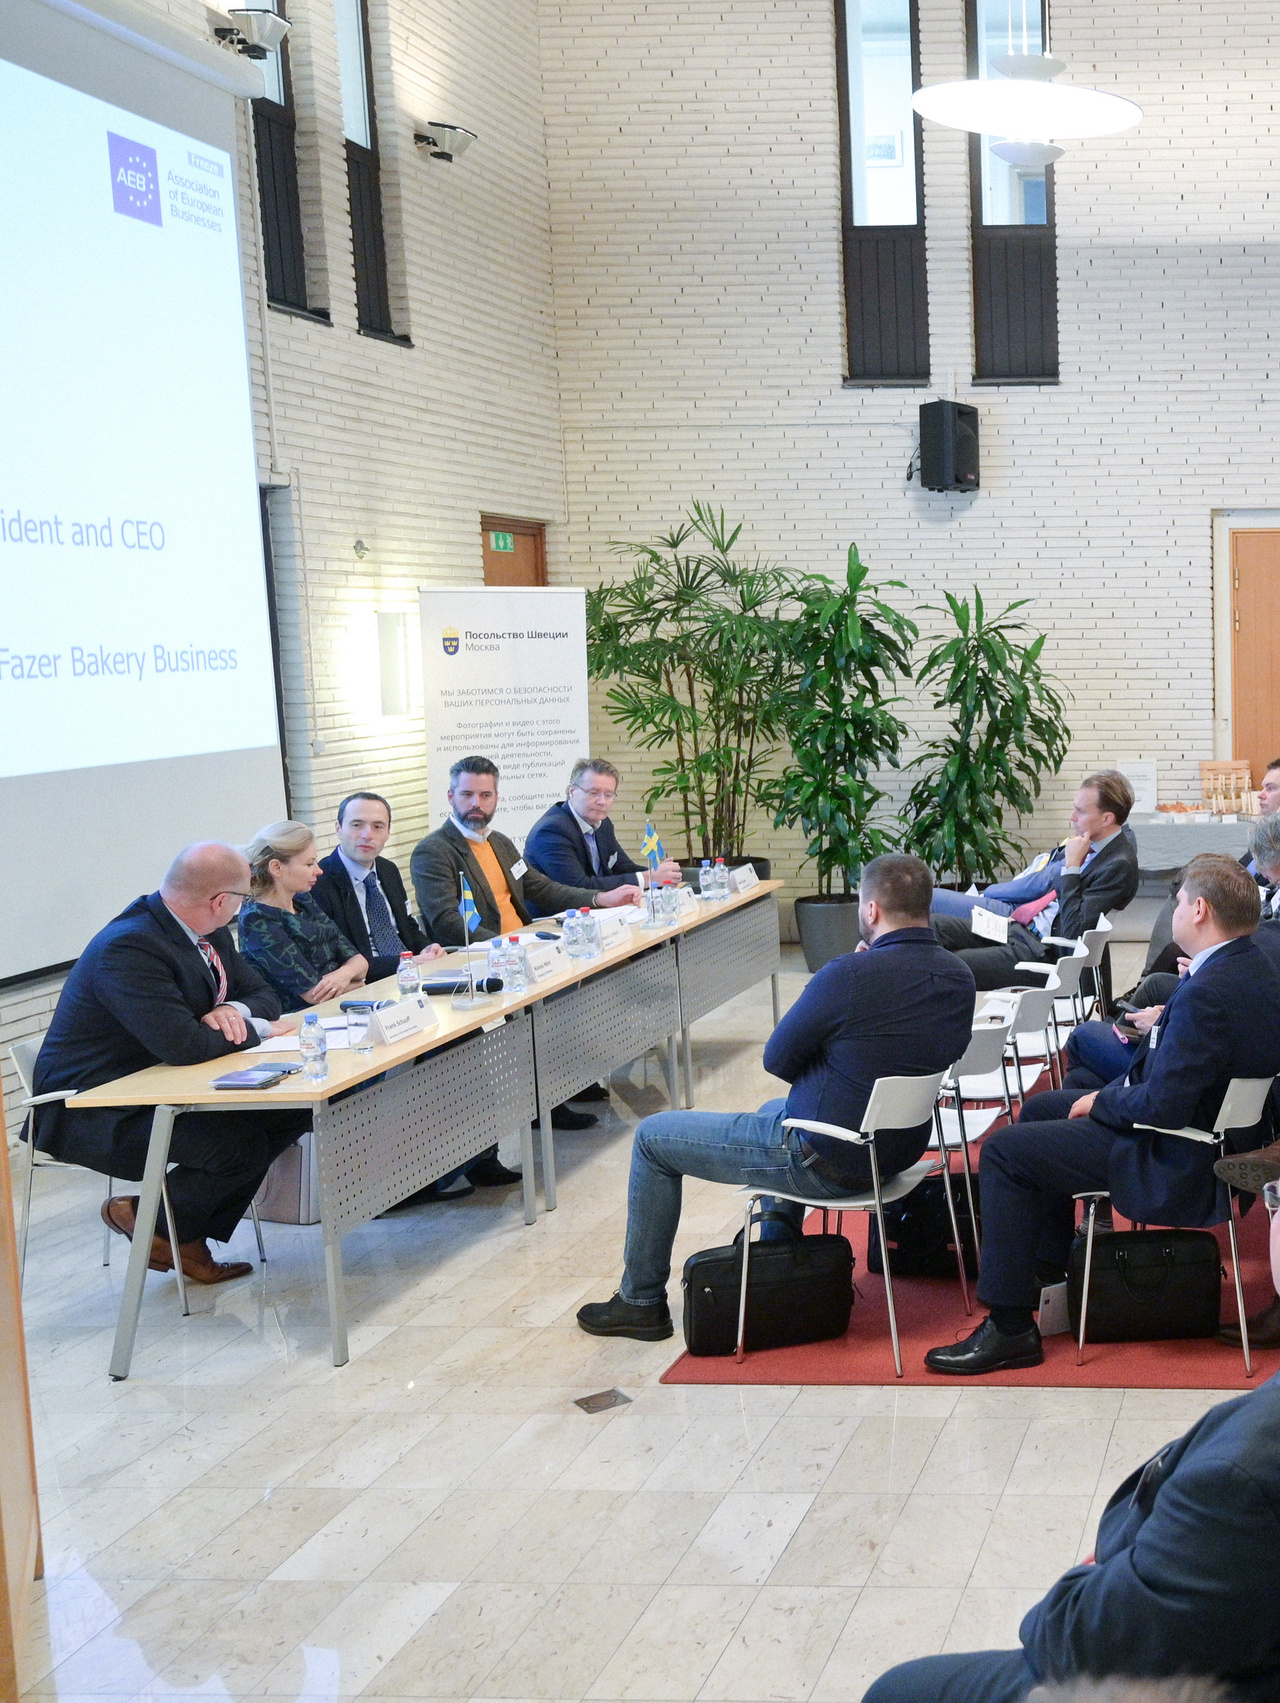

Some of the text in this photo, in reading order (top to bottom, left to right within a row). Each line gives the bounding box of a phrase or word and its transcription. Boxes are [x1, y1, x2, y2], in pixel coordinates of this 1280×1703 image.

[116, 166, 146, 192] AEB
[167, 170, 220, 200] Association
[169, 190, 224, 218] of European
[170, 203, 222, 232] Businesses
[71, 517, 113, 548] and
[120, 519, 166, 551] CEO
[465, 630, 569, 640] Посольство Швеции
[465, 643, 501, 652] Москва
[0, 643, 238, 681] Fazer Bakery Business
[440, 685, 573, 697] МЫ ЗАБОТИМСЯ О БЕЗОПАСНОСТИ
[444, 696, 570, 708] ВАШИХ ПЕРСОНАЛЬНЫХ ДАННЫХ
[456, 720, 504, 730] Фотографии
[512, 720, 535, 728] видео
[541, 718, 561, 726] этого
[440, 728, 576, 742] мероприятия могут быть сохранены
[443, 743, 500, 752] использованы
[500, 742, 514, 750] для
[515, 738, 580, 749] информирования
[502, 763, 521, 771] виде
[522, 759, 566, 770] публикаций
[508, 792, 545, 802] сообщите
[511, 803, 534, 812] чтобы
